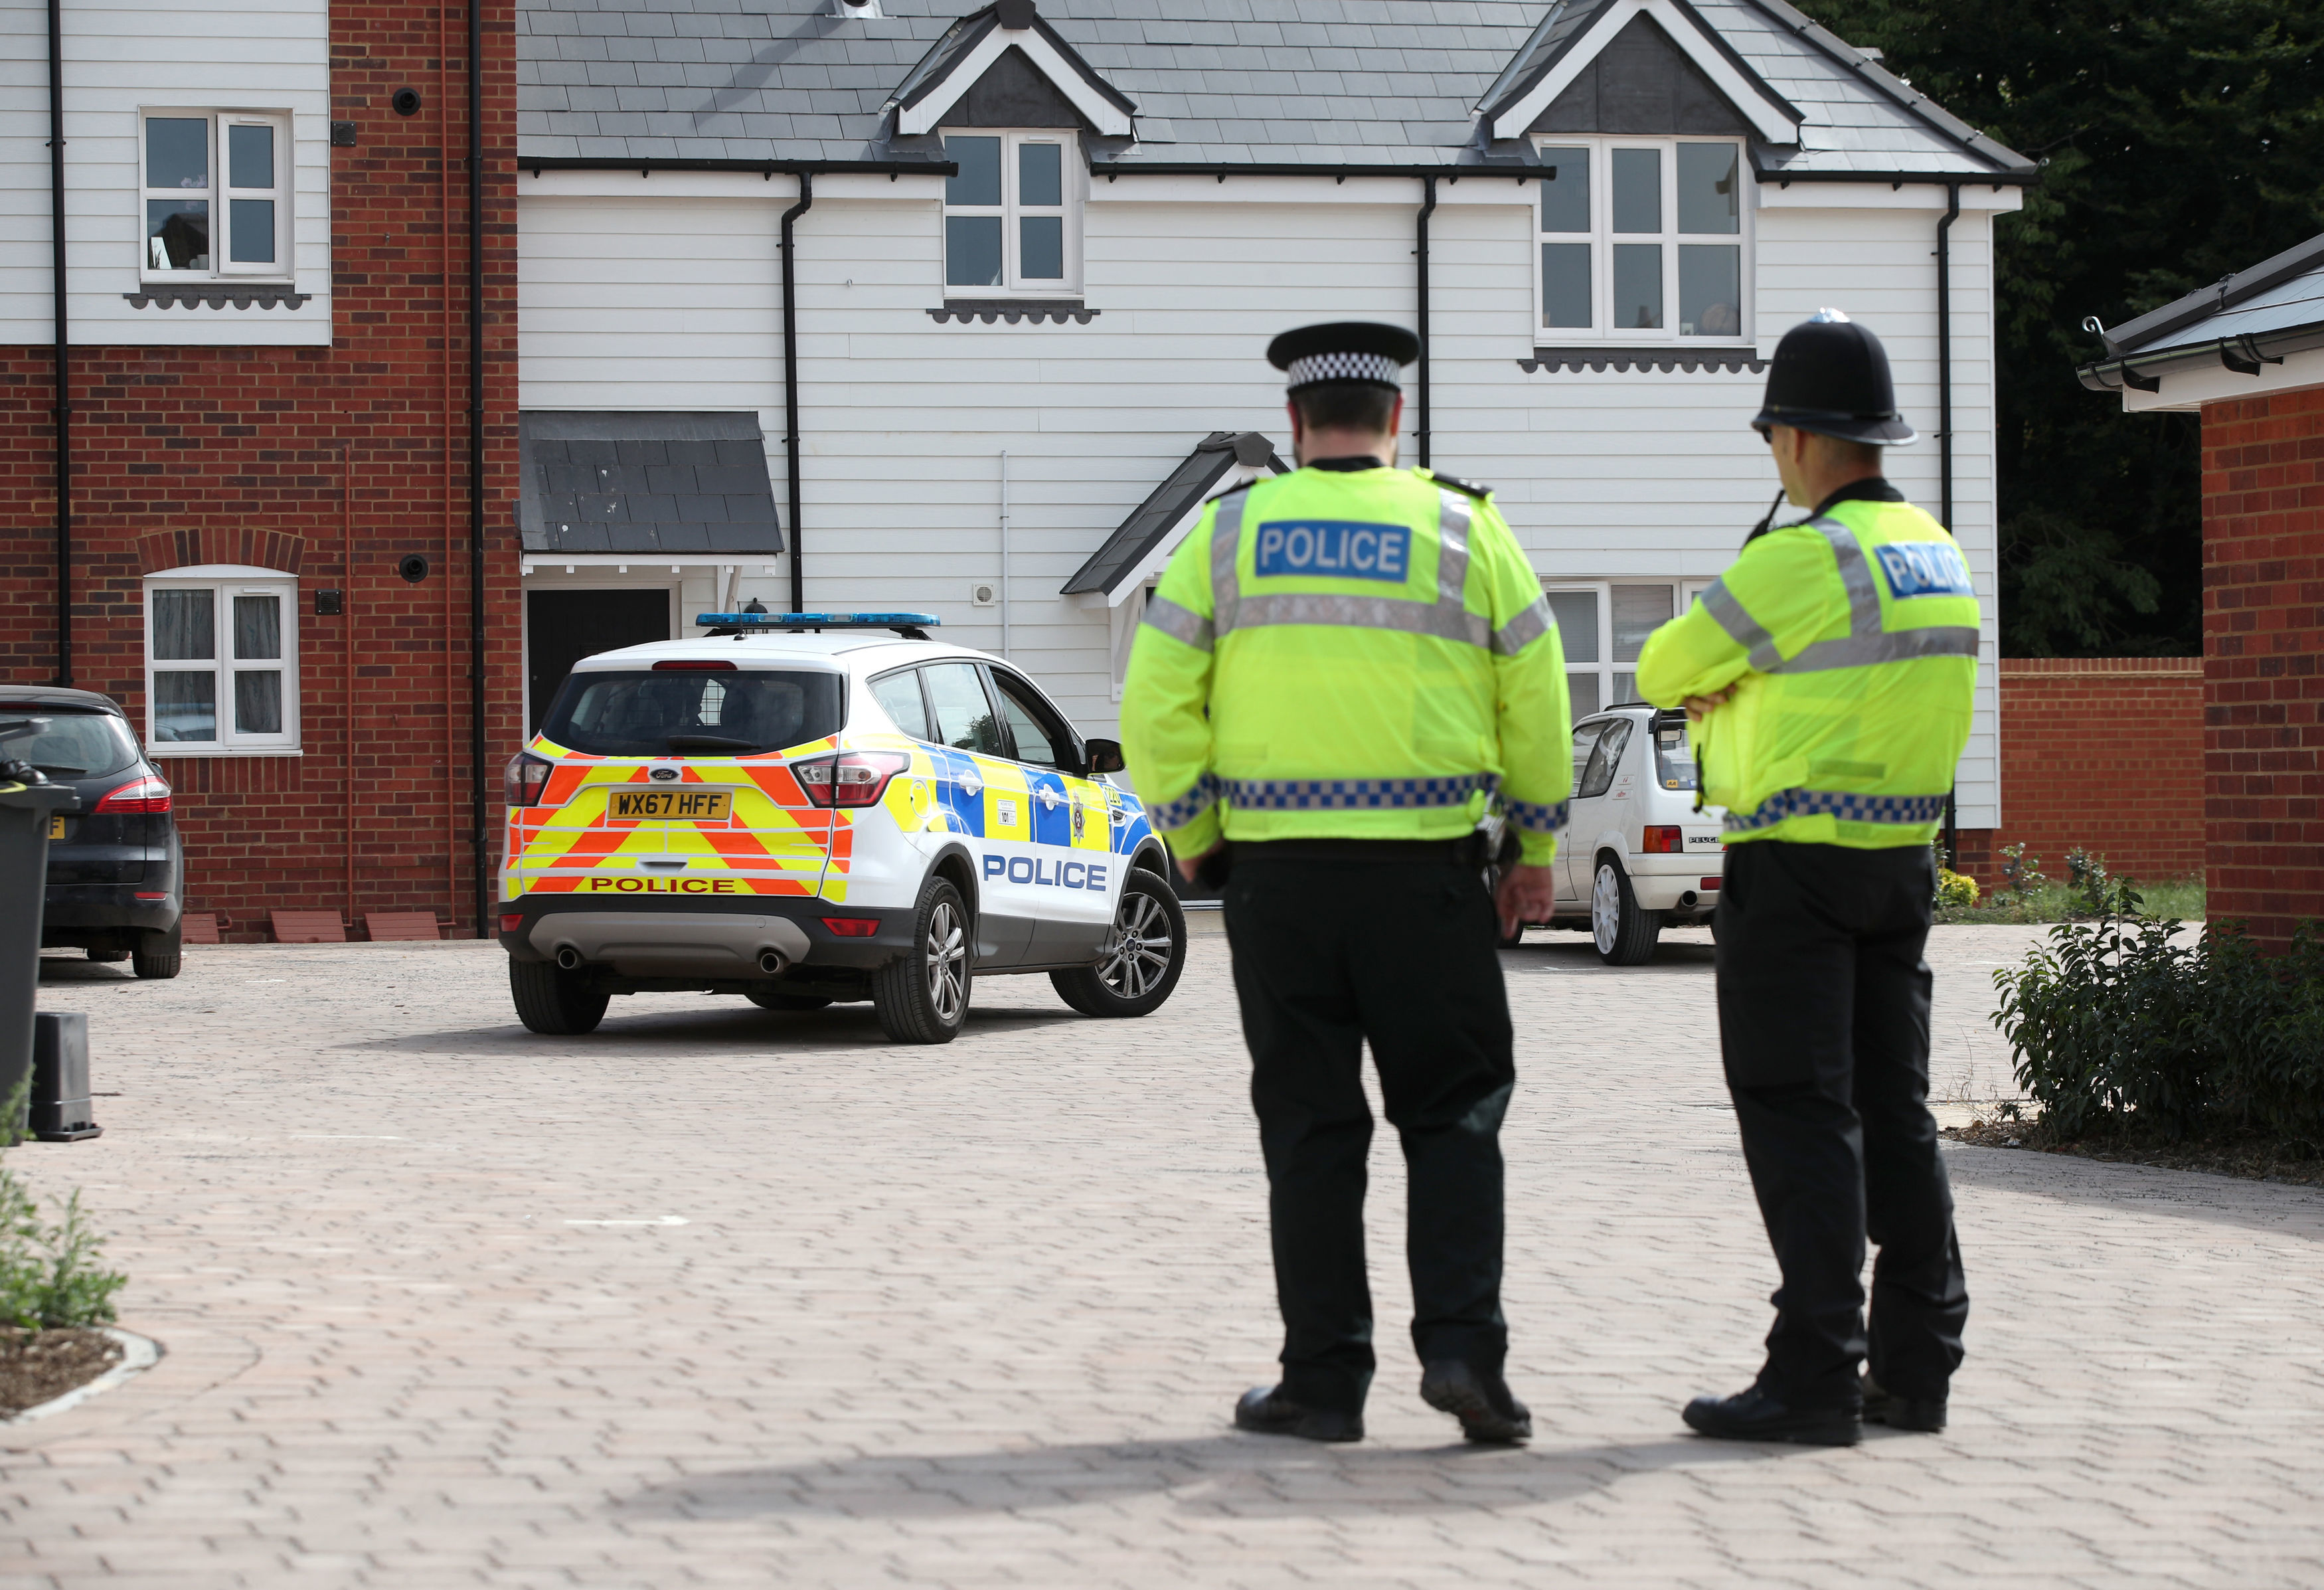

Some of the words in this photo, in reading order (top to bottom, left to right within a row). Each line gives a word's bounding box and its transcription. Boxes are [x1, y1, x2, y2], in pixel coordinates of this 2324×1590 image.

[1260, 527, 1403, 573] POLICE
[1884, 549, 1972, 590] POLIC
[618, 794, 673, 815] WX67
[679, 794, 722, 815] HFF
[591, 877, 735, 893] POLICE
[982, 854, 1107, 892] POLICE
